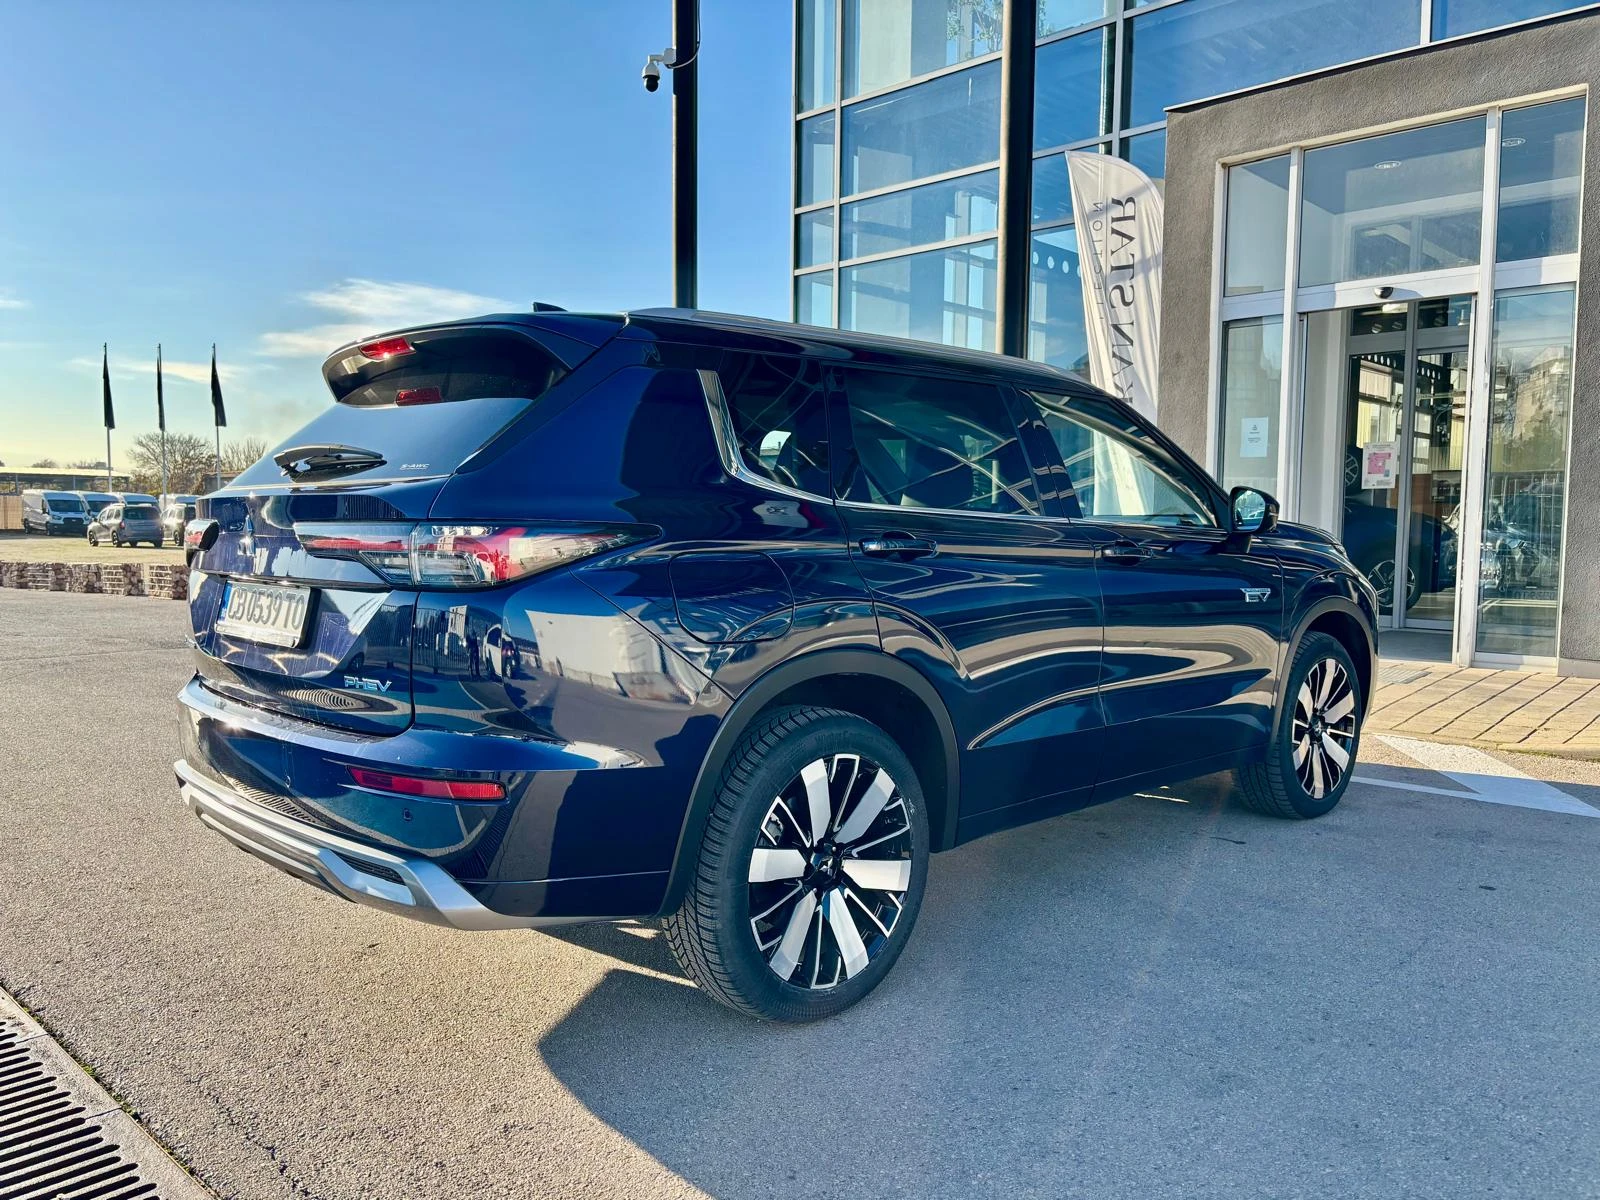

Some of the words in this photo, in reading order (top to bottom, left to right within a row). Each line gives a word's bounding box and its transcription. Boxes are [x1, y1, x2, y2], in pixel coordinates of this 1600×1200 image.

[228, 588, 247, 621] CB
[247, 589, 282, 626] 0539
[284, 593, 305, 631] TO
[343, 675, 393, 693] PHEV
